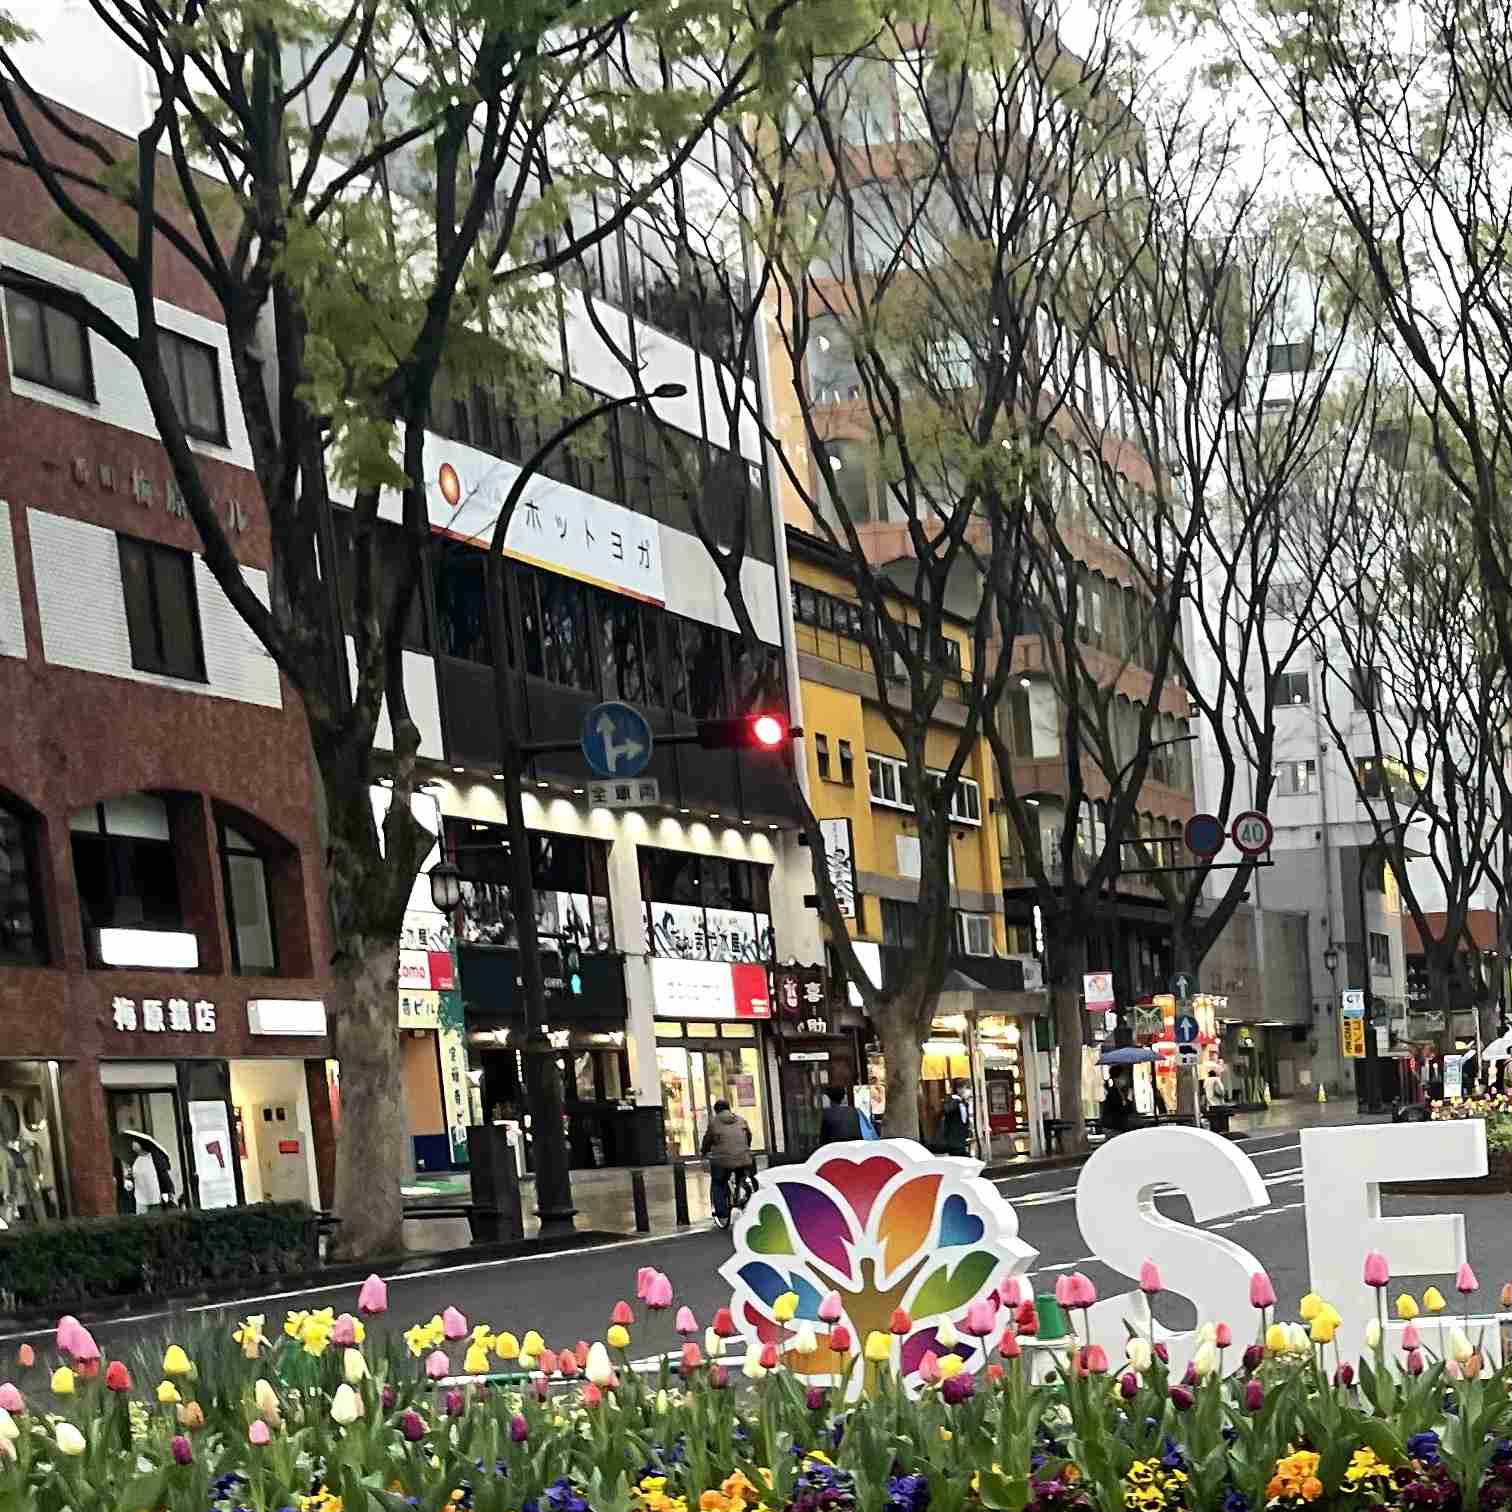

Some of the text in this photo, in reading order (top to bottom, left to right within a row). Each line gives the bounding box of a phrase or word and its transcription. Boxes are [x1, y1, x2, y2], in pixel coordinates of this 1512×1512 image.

[525, 500, 650, 569] ホットヨガ
[1241, 823, 1265, 842] 40
